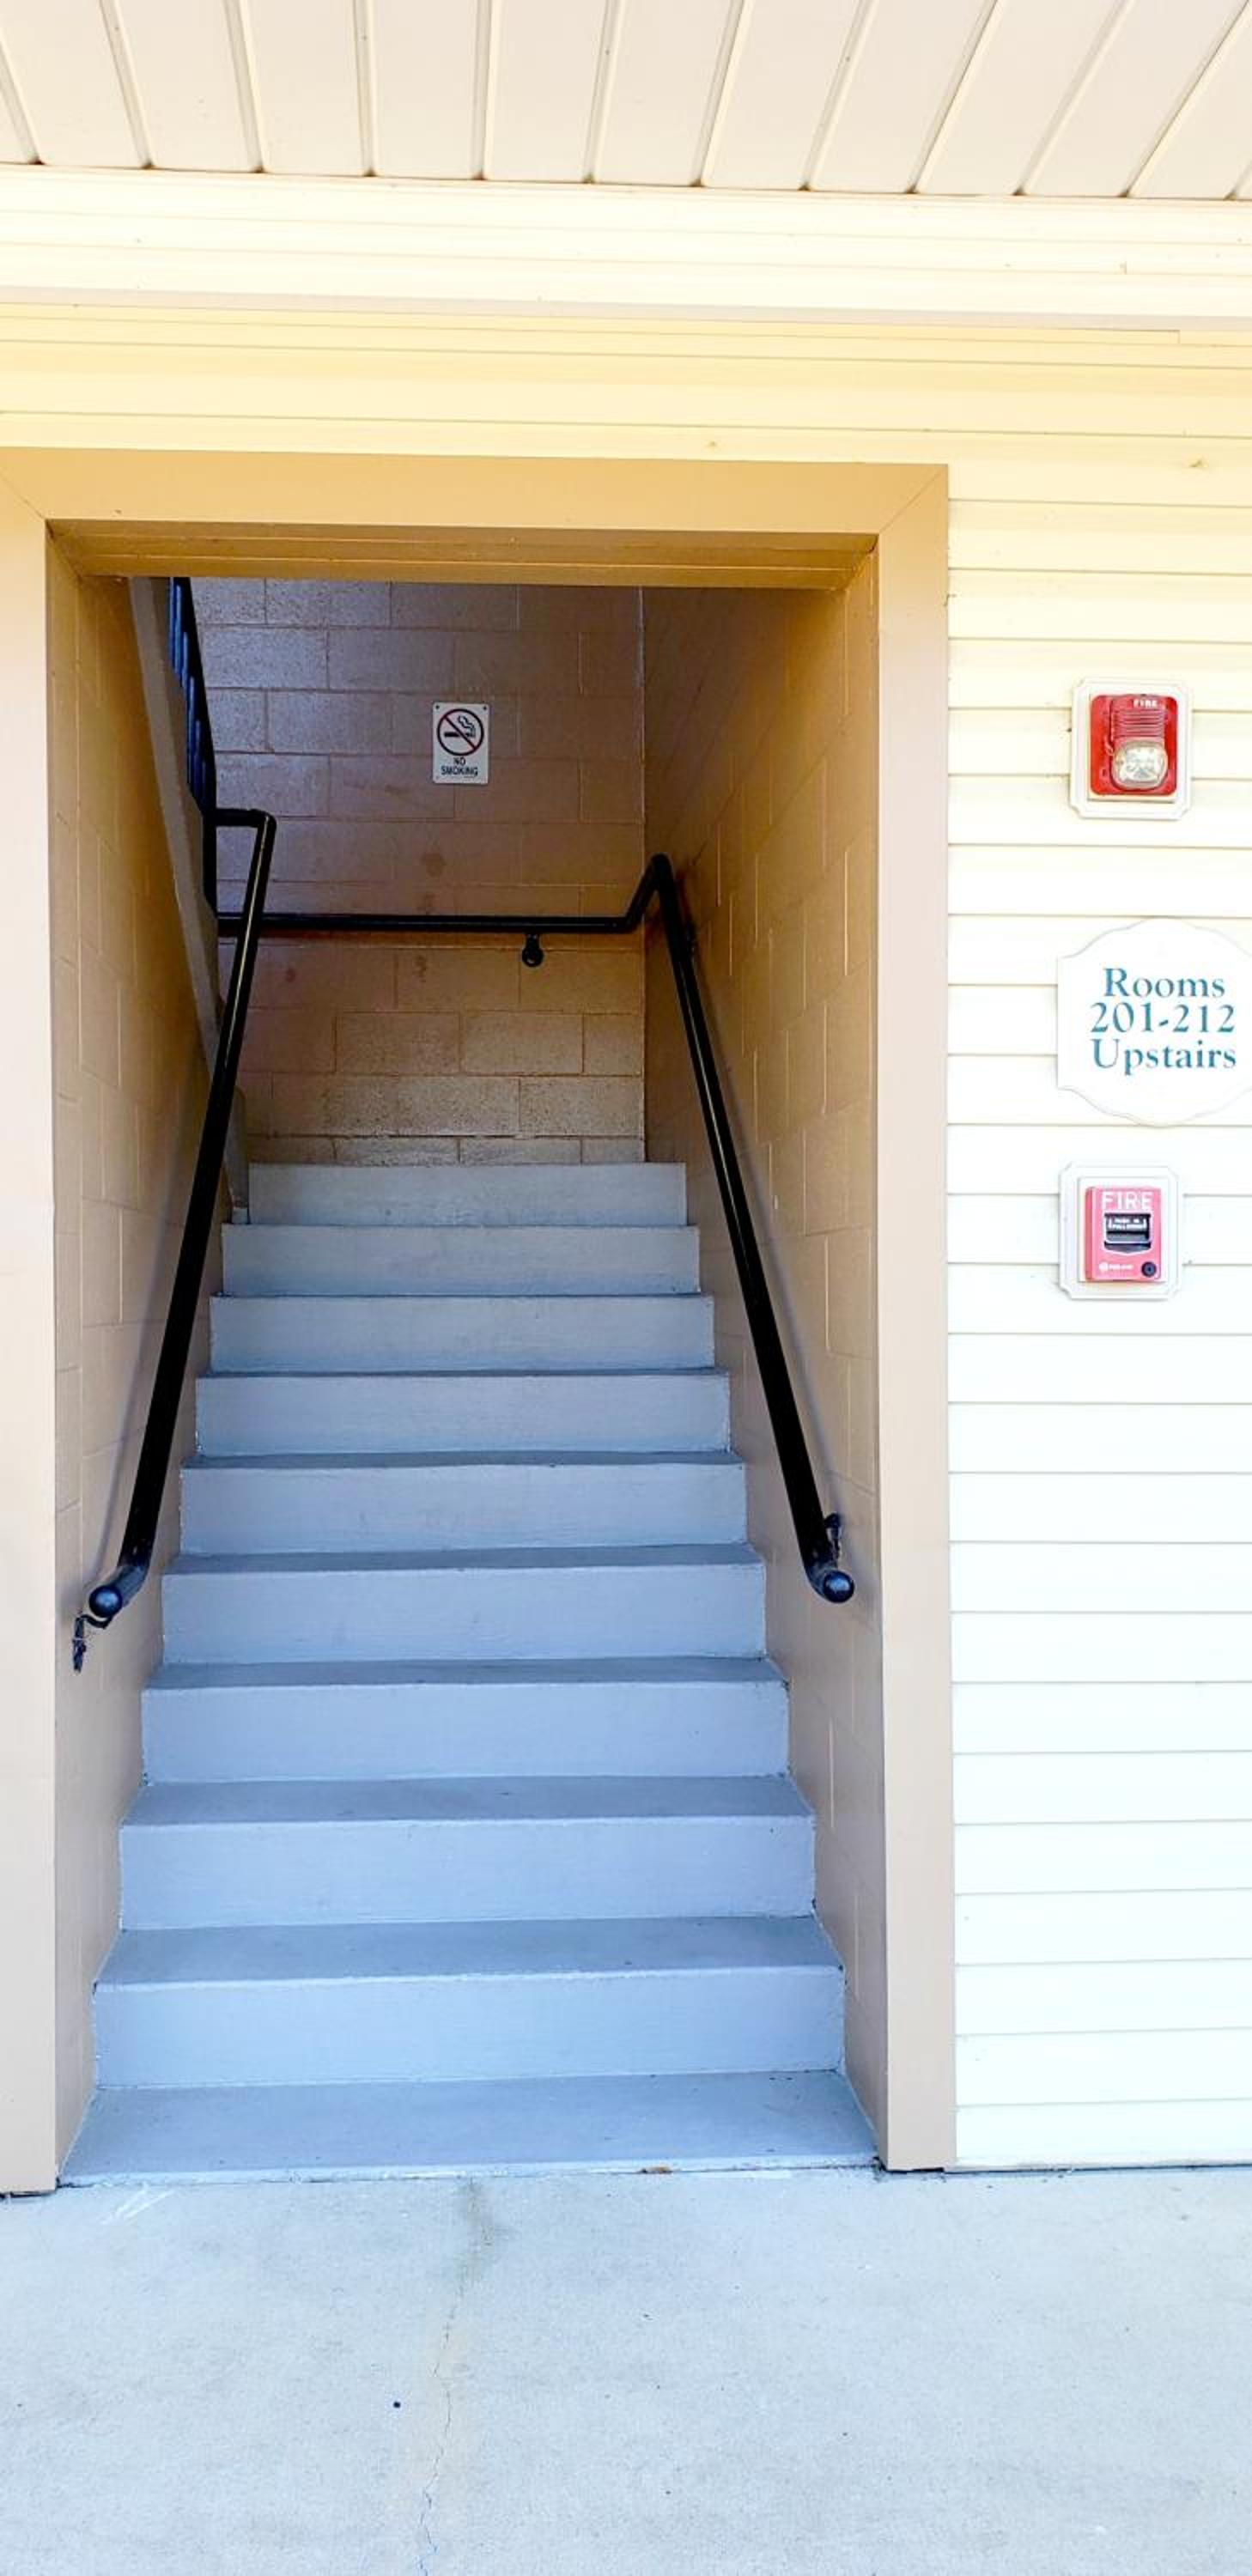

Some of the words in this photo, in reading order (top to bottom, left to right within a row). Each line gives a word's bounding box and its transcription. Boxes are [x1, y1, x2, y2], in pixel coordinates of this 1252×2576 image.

[1133, 699, 1158, 708] FIRE
[441, 765, 478, 776] SMOKING
[453, 757, 465, 766] NO
[1103, 967, 1226, 999] Rooms
[1090, 1001, 1236, 1033] 201-212
[1090, 1038, 1237, 1076] Upstairs
[1102, 1191, 1153, 1210] FIRE
